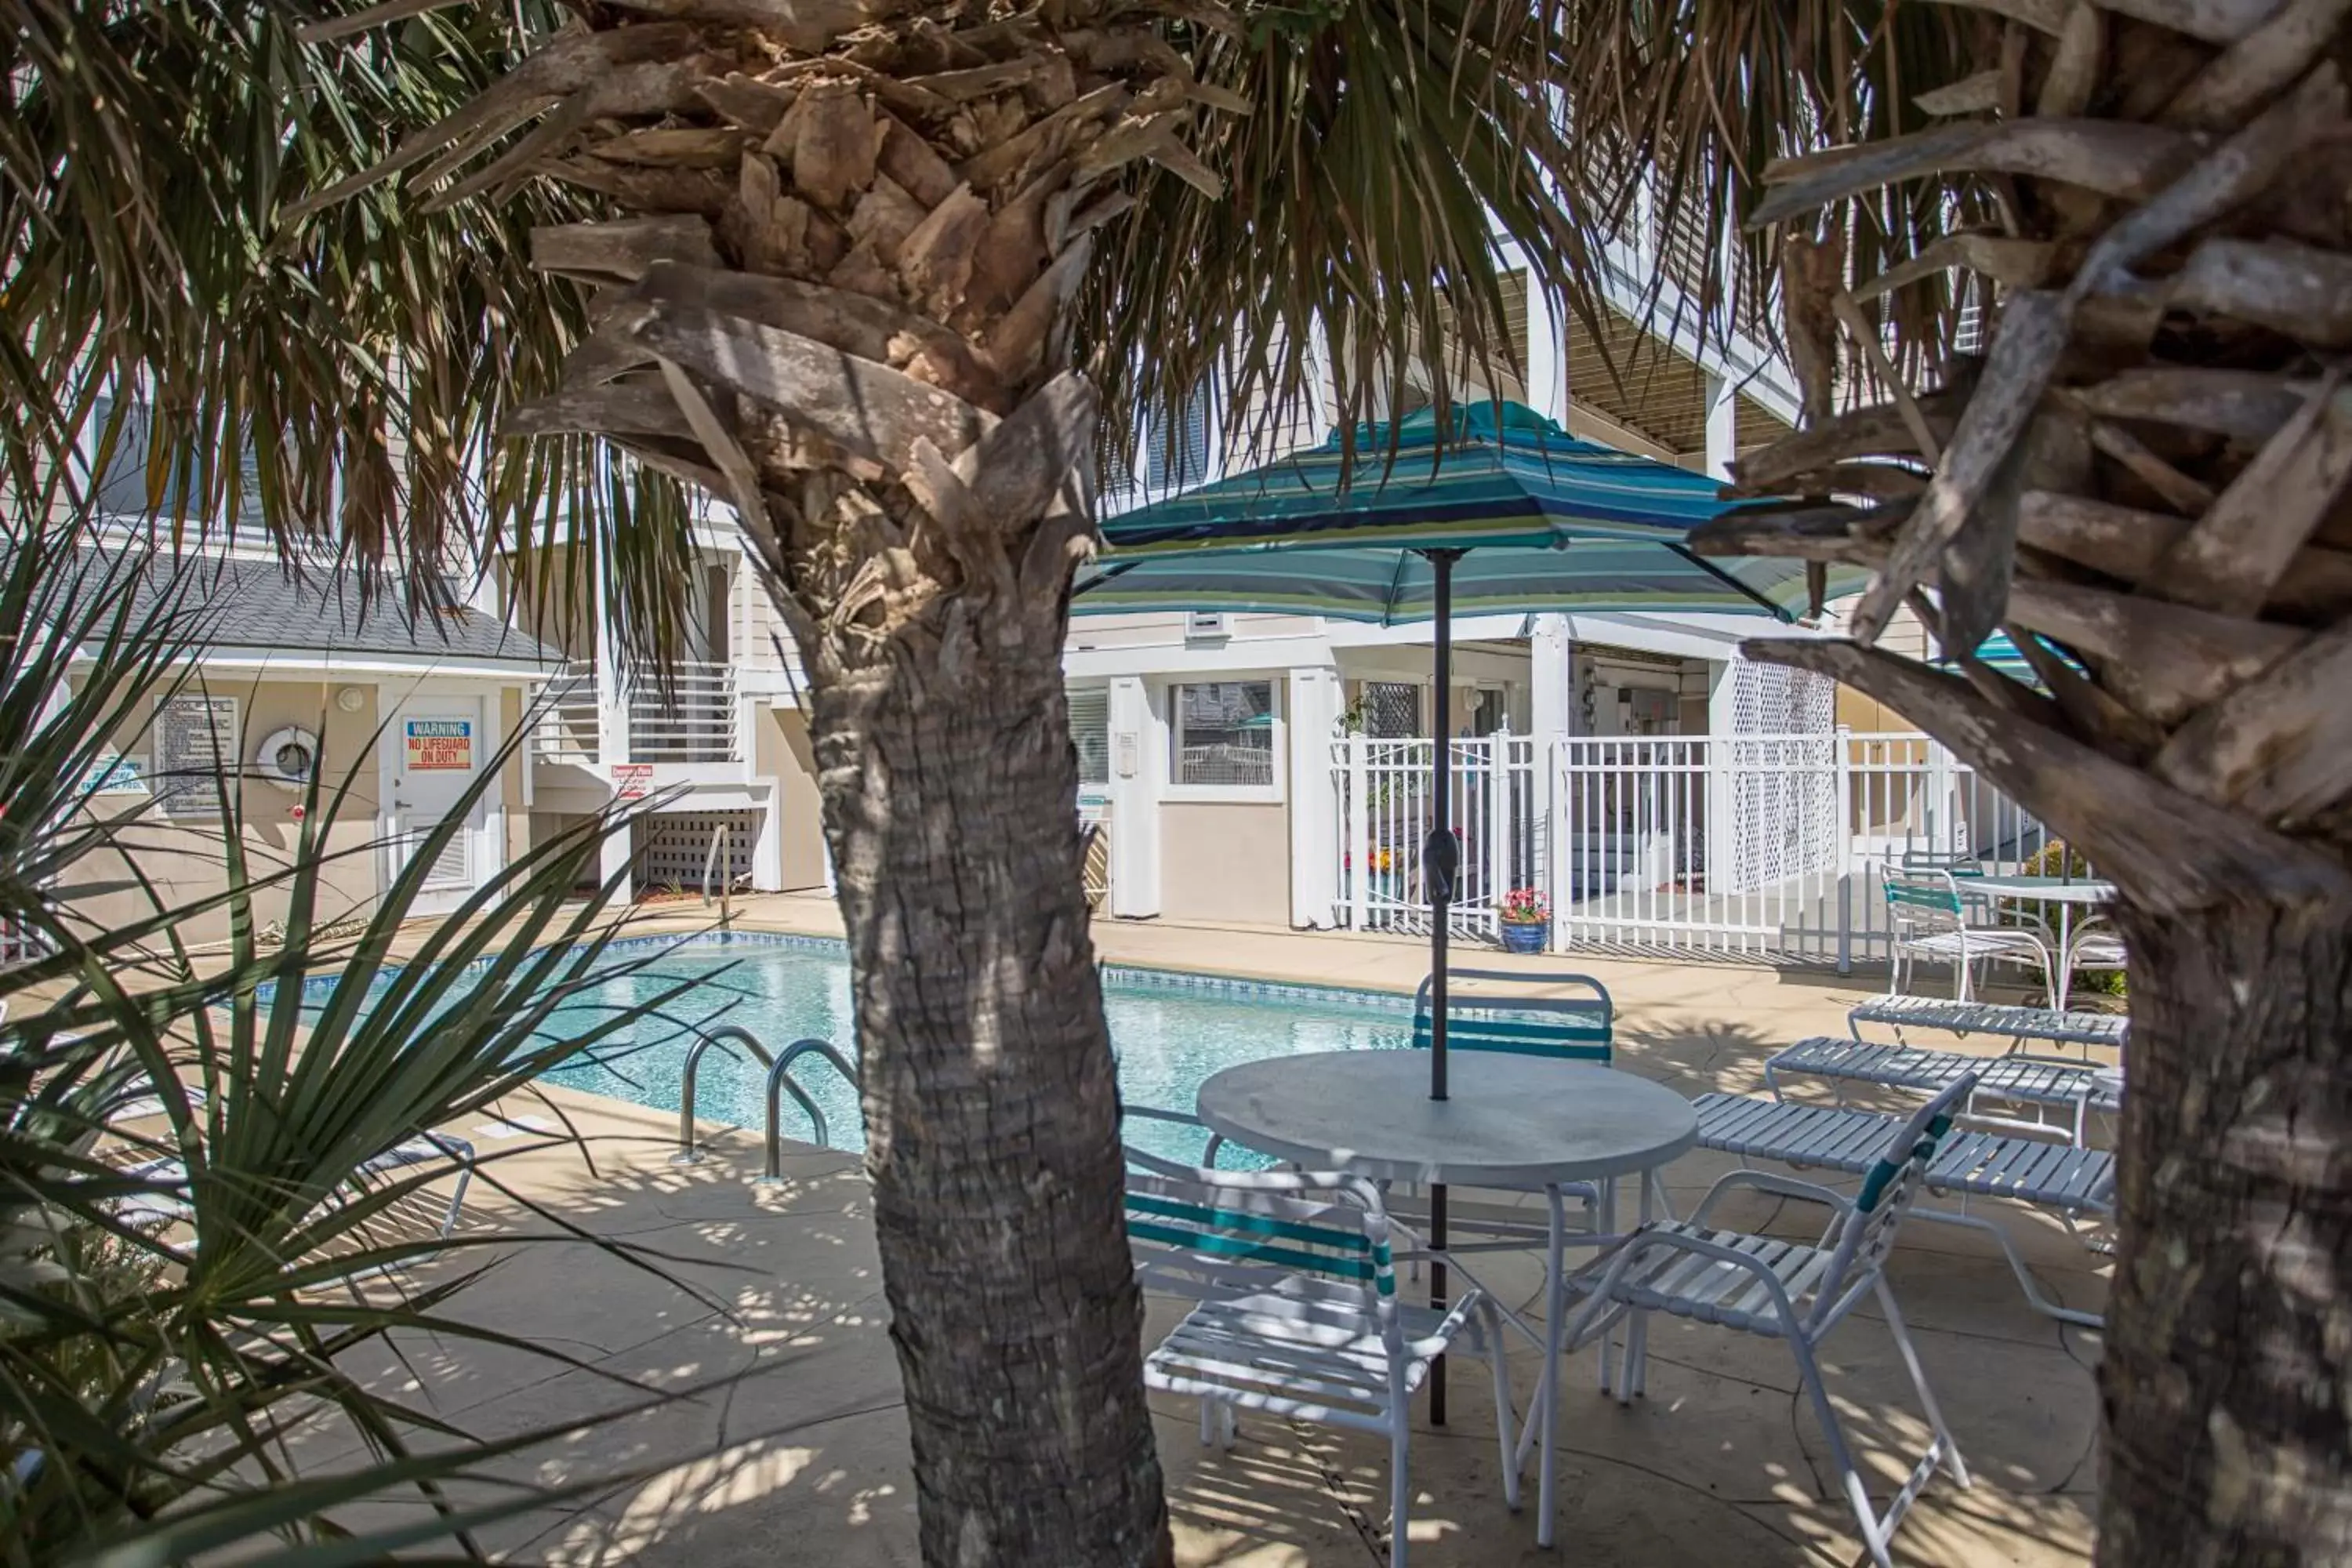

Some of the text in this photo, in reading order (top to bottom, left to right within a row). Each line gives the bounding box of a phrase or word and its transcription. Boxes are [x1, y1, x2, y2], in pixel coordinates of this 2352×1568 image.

[413, 722, 465, 735] WARNING
[408, 738, 470, 750] NO LIFEGUARD
[421, 751, 457, 763] ON DUTY
